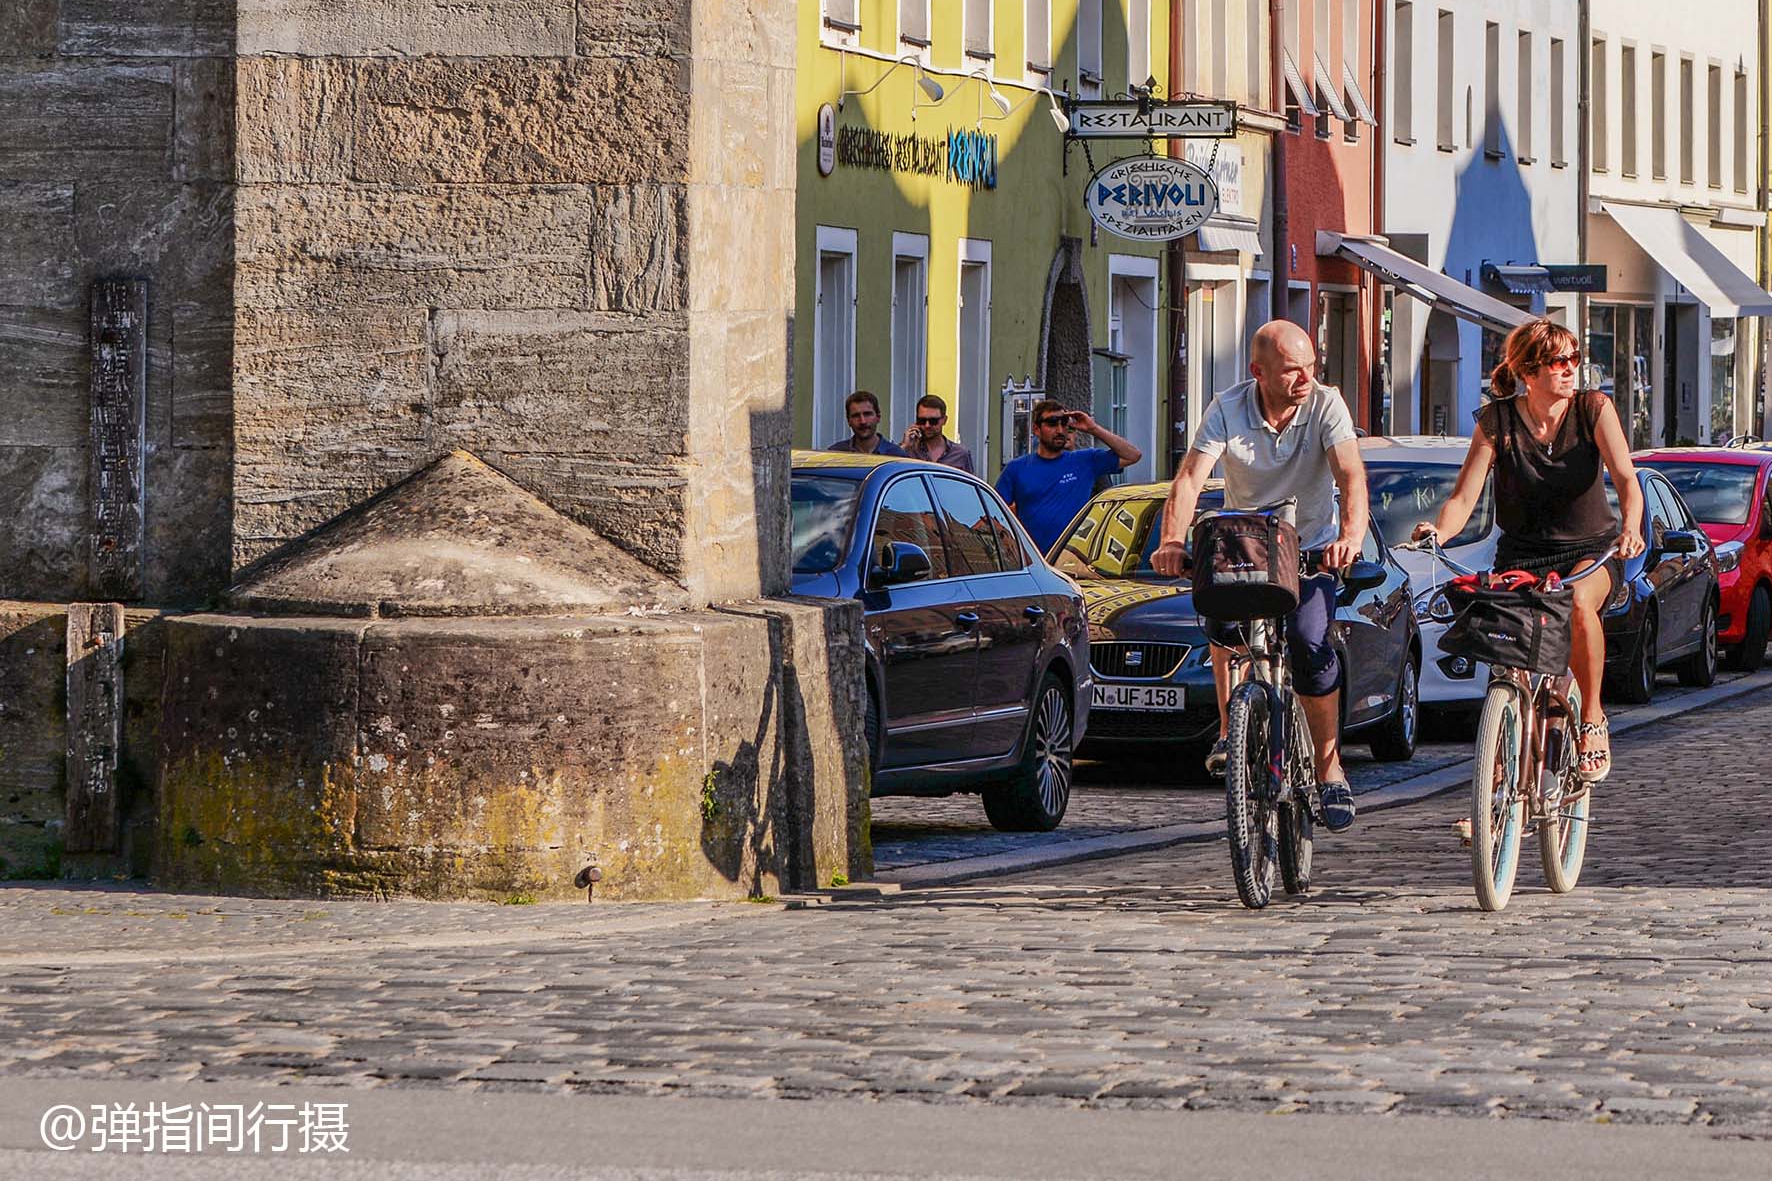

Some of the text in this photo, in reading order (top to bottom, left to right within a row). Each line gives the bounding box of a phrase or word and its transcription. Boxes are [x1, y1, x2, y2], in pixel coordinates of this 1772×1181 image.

[1079, 112, 1225, 128] RESTAURANT
[1110, 162, 1193, 181] GRIECHISCHE
[1098, 183, 1205, 208] PERIVOLI
[1100, 210, 1203, 237] SPEZIALITÄTEN
[1117, 688, 1141, 705] UF
[1144, 689, 1178, 707] 158
